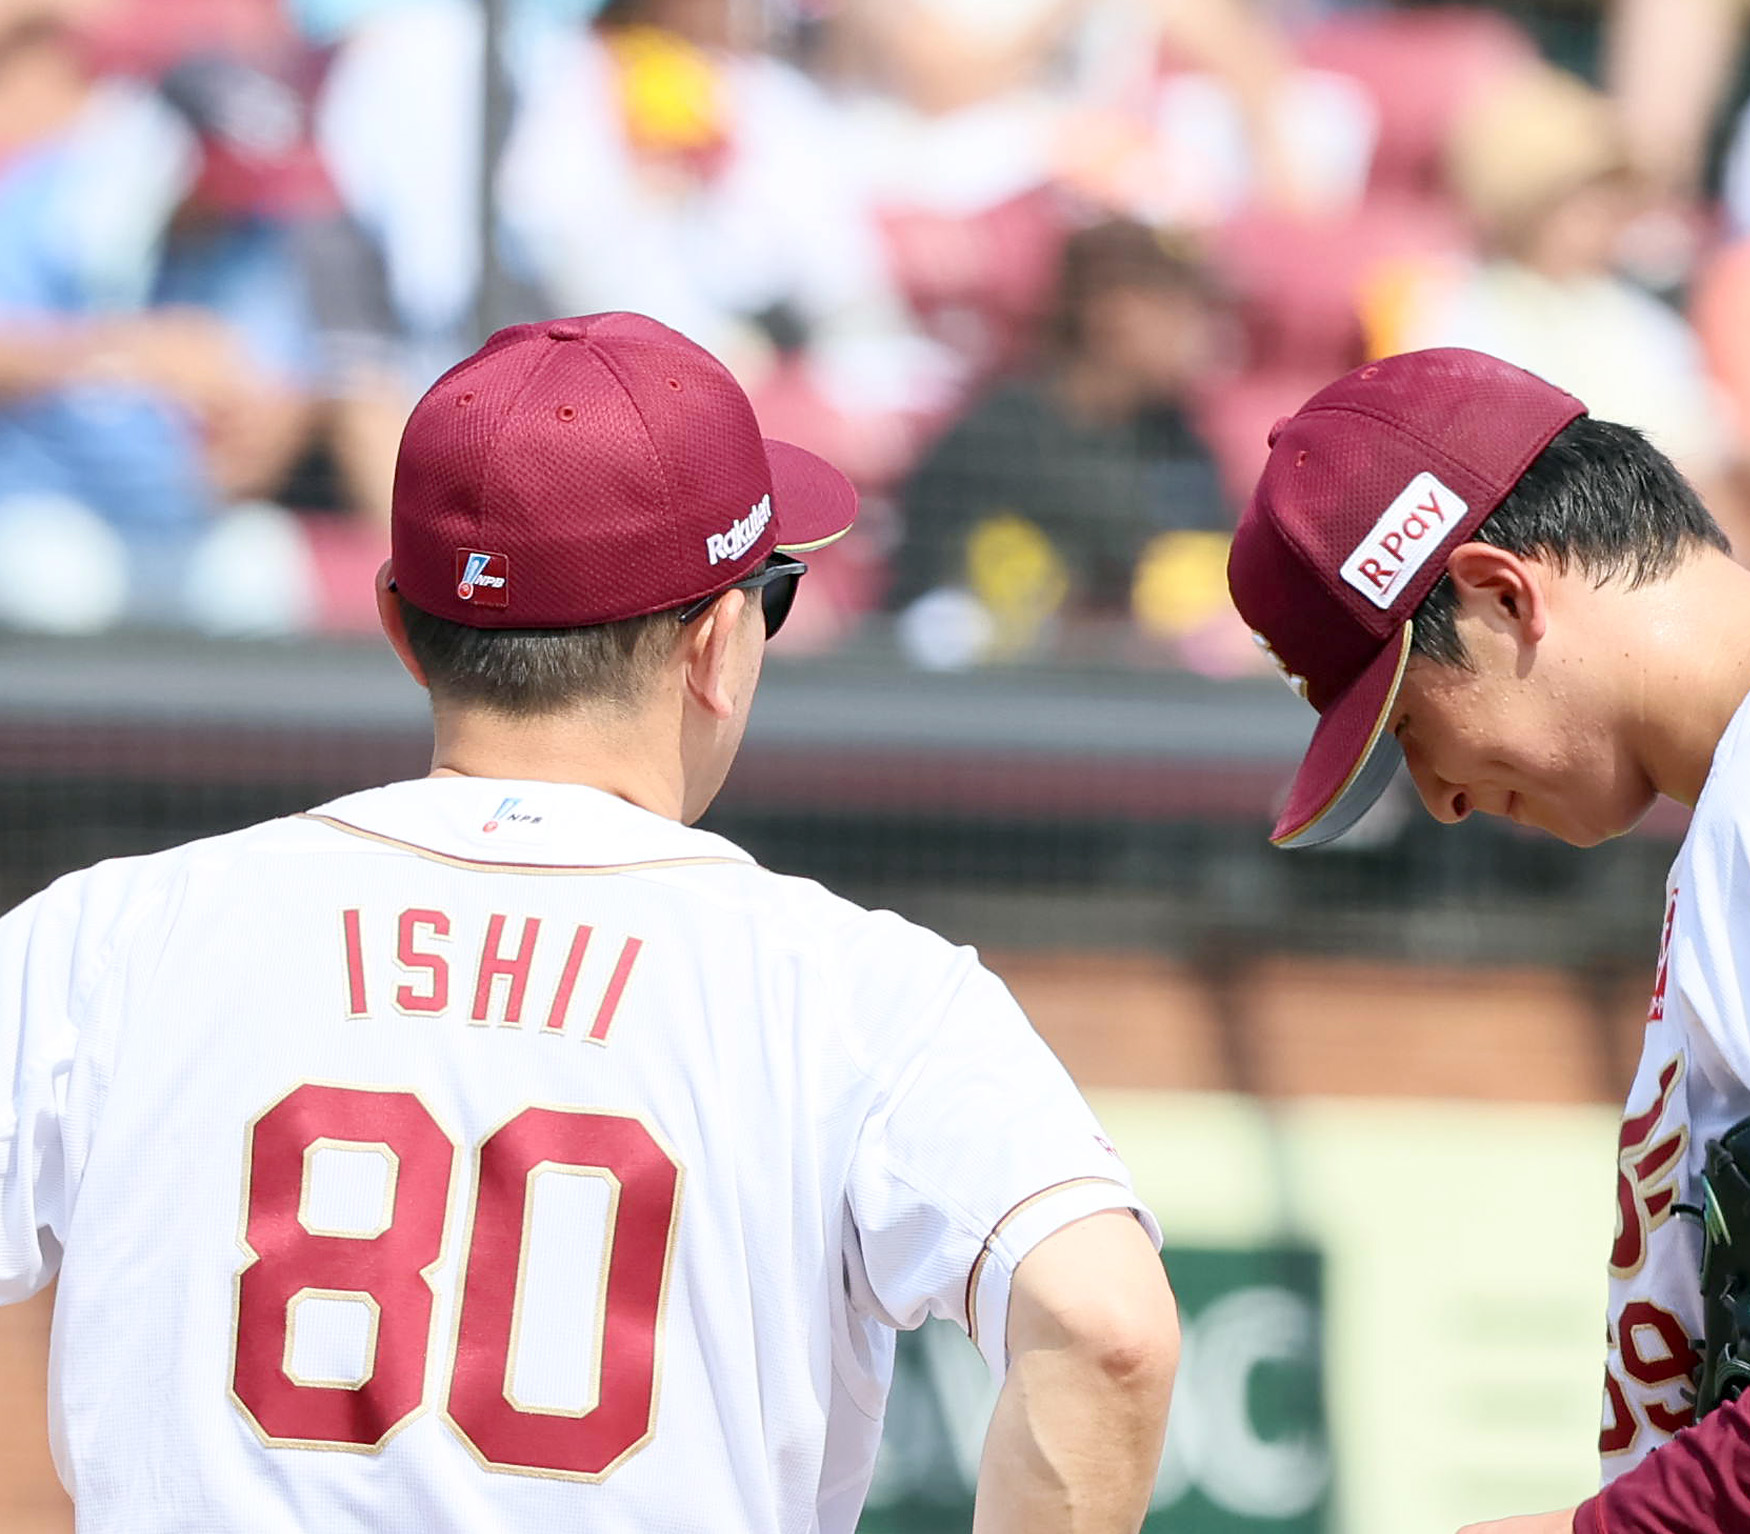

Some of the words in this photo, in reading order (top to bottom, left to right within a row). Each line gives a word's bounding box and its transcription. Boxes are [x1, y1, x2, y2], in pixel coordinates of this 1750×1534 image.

[705, 493, 772, 566] Rakuten
[1378, 490, 1446, 563] Pay
[338, 906, 644, 1048] ISHII
[230, 1076, 687, 1485] 80
